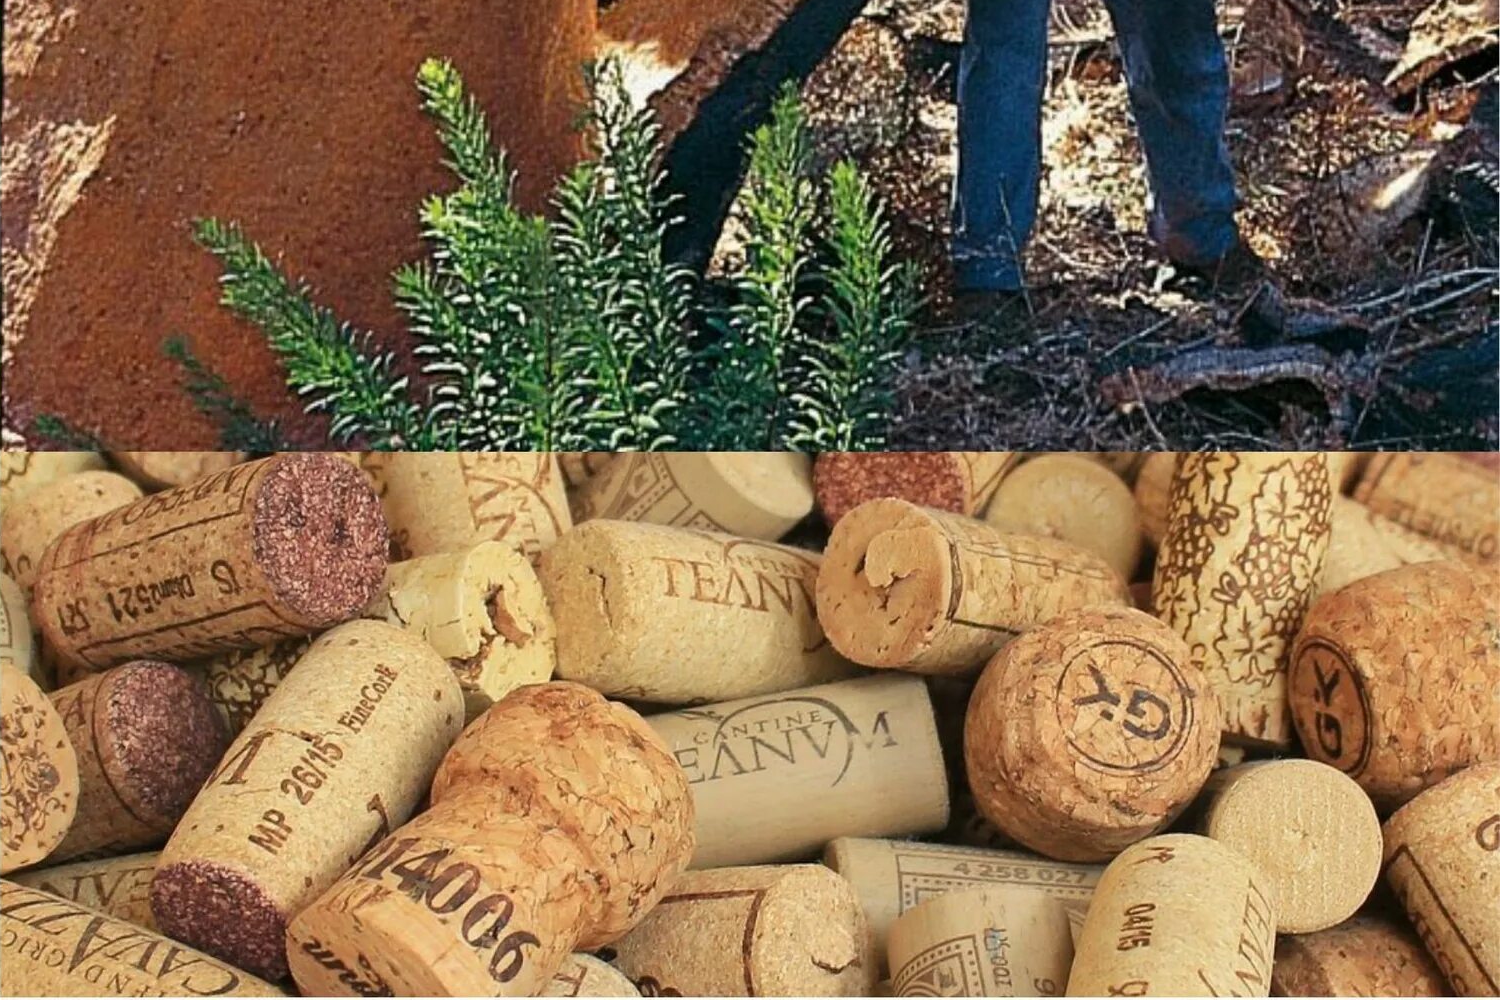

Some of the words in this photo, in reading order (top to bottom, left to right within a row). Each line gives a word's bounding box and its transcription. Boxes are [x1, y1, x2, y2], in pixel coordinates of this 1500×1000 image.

[248, 808, 293, 856] MP
[280, 736, 345, 806] 26/15
[337, 663, 400, 735] FineCork
[692, 709, 823, 745] CANTINE
